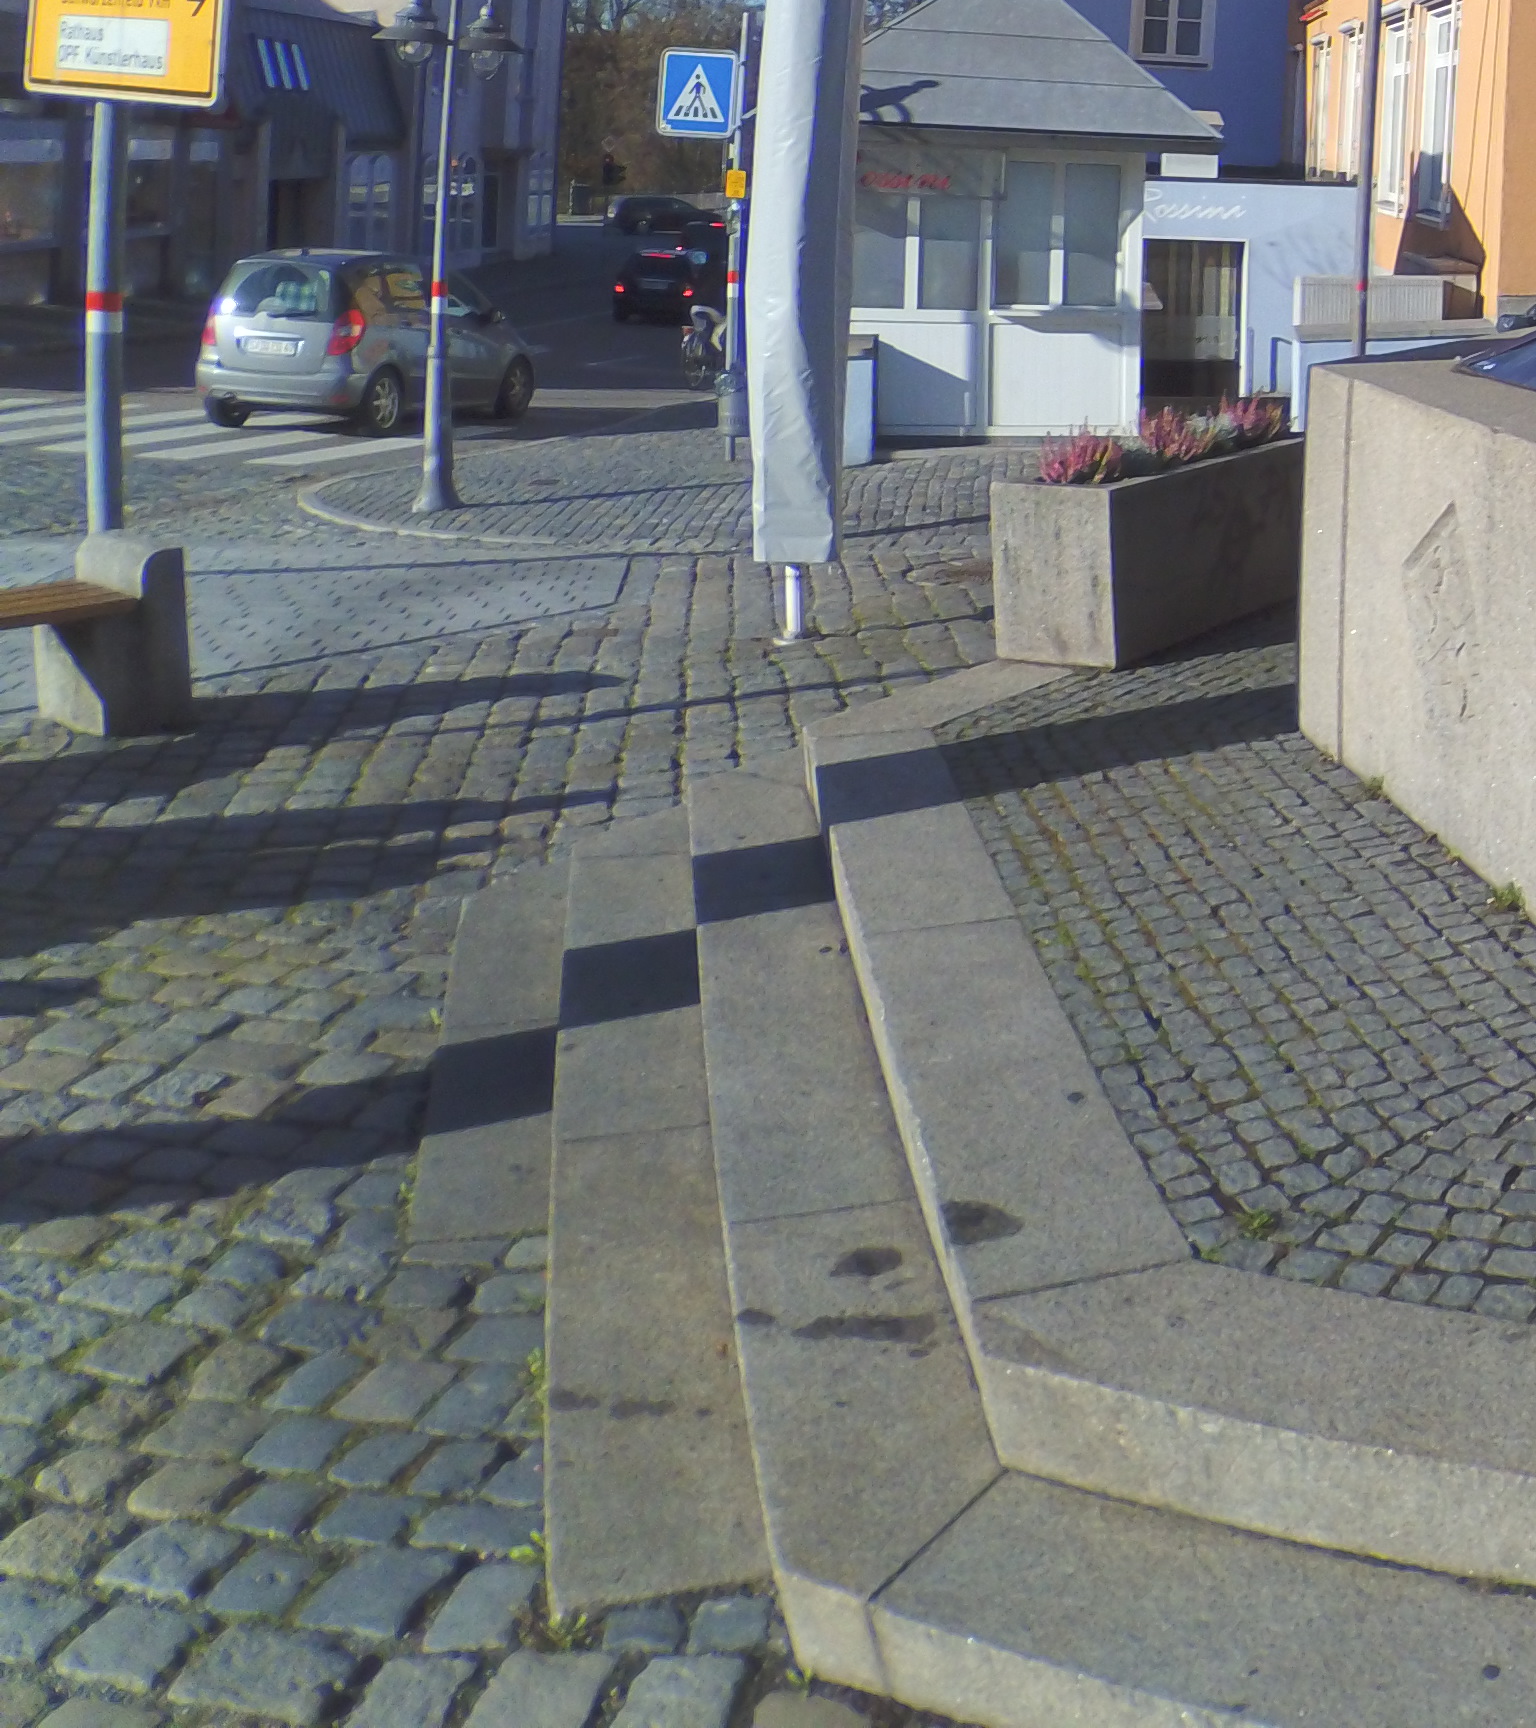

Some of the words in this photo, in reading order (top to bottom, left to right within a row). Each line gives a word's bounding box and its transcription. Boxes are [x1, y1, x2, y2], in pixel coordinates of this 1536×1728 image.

[60, 20, 104, 41] Rathaus
[84, 46, 163, 70] Künstlerhaus
[857, 154, 951, 189] ossini
[1144, 188, 1247, 222] Rossini
